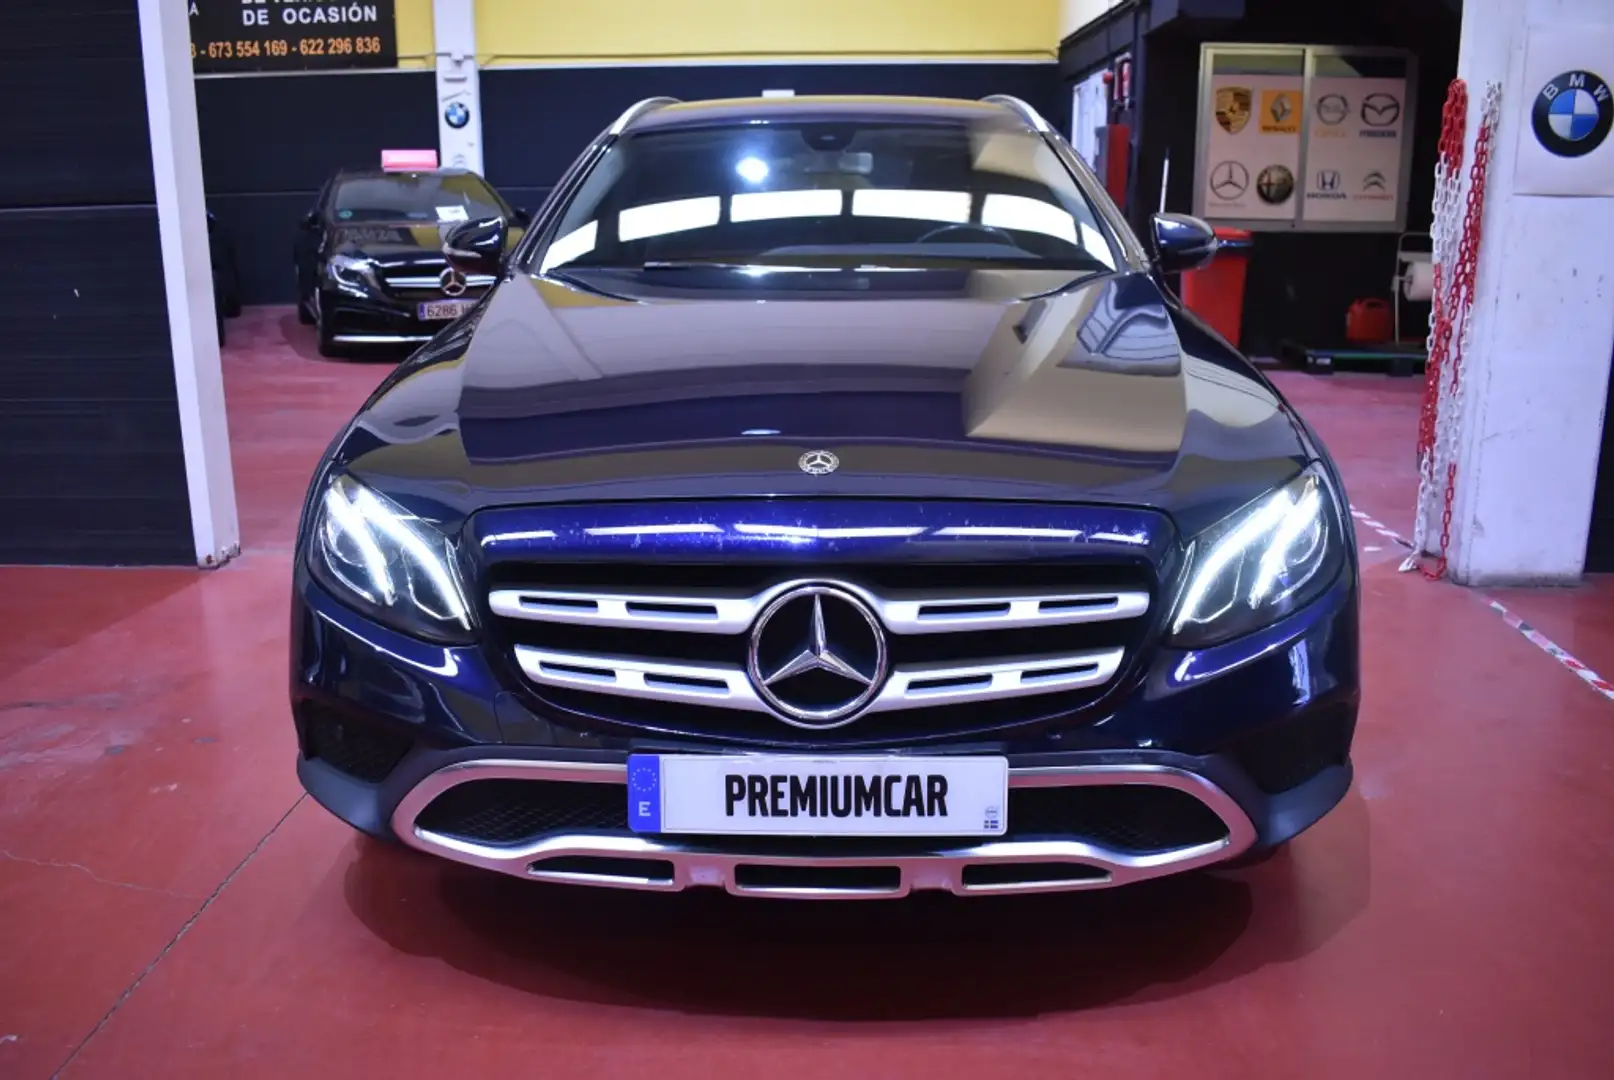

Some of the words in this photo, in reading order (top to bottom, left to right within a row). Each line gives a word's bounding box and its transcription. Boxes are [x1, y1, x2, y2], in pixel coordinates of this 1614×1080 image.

[242, 9, 269, 26] DE
[282, 3, 377, 24] OCASIÓN
[208, 41, 233, 58] 673
[236, 40, 260, 58] 554
[264, 39, 288, 56] 169
[300, 38, 325, 55] 622
[327, 37, 352, 54] 296
[356, 36, 380, 53] 836
[1542, 73, 1609, 103] BMW
[724, 773, 949, 818] PREMIUMCAR
[638, 800, 652, 817] E
